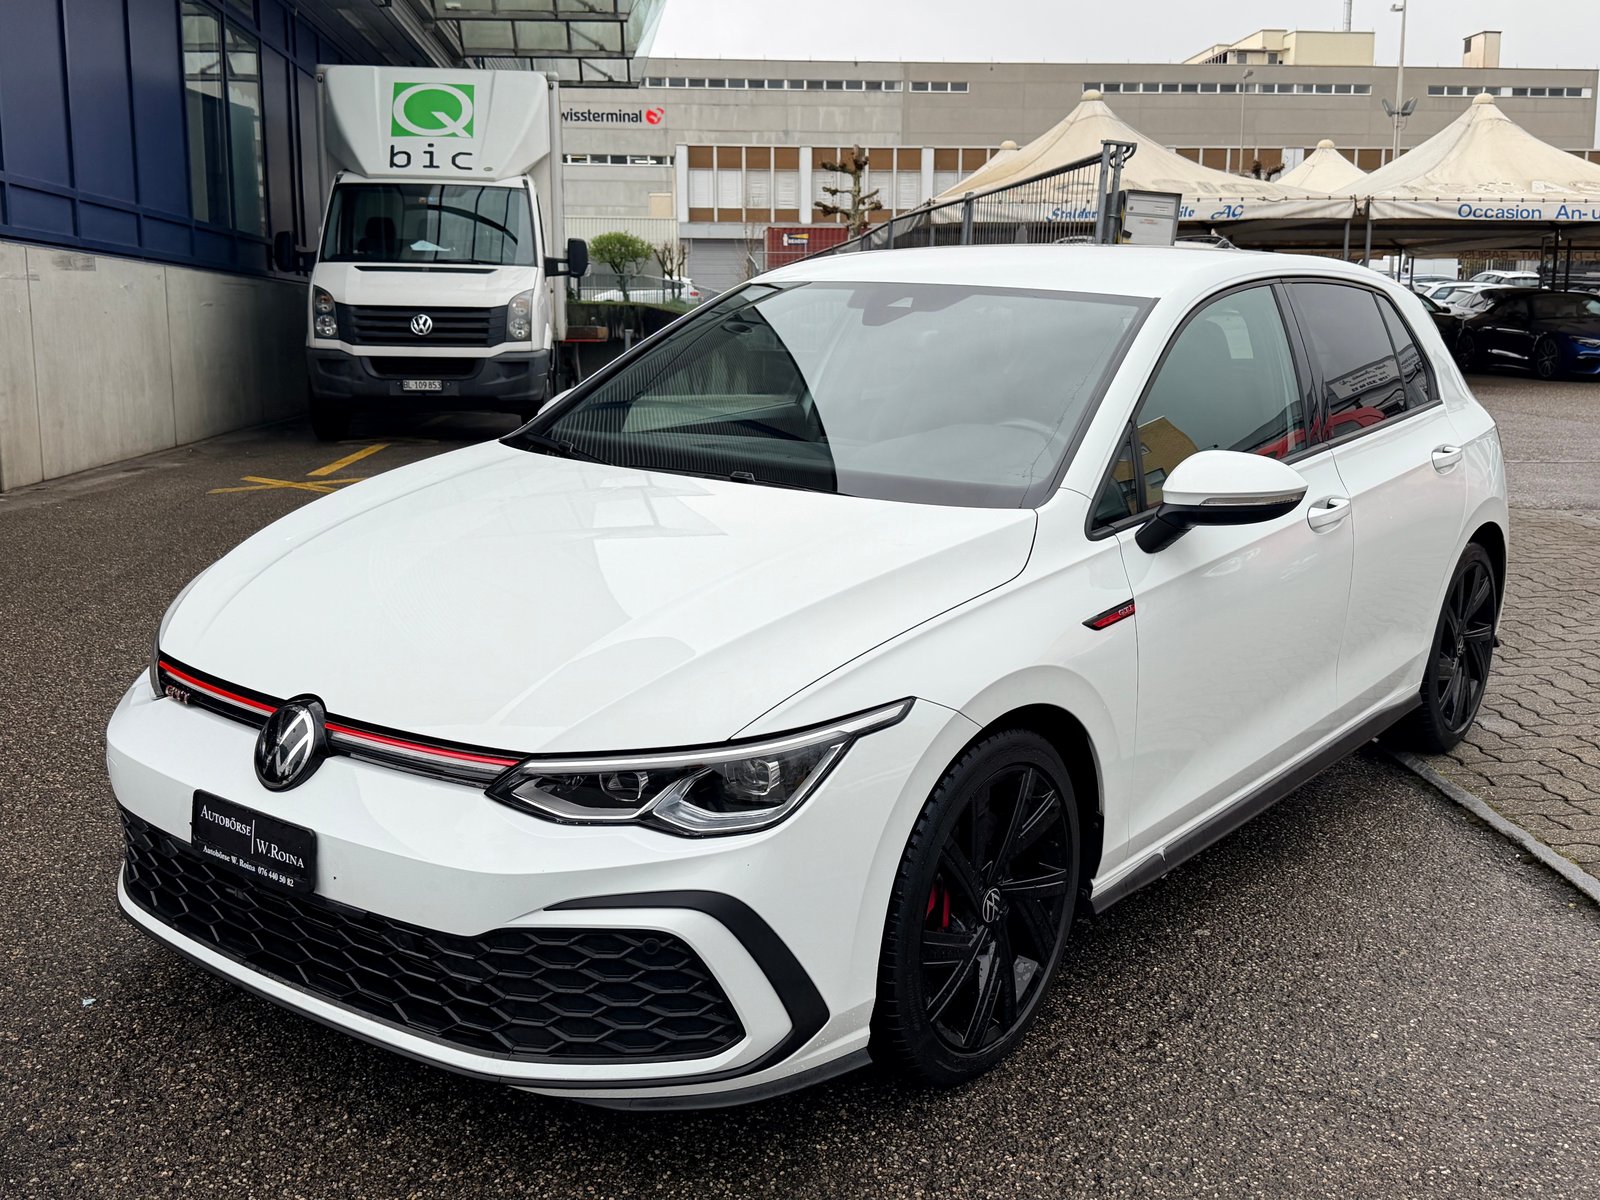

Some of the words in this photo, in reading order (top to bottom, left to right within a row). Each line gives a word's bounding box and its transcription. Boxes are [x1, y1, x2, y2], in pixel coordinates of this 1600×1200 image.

[392, 82, 475, 138] Q
[1210, 204, 1245, 220] AG
[1457, 203, 1542, 220] Occasion
[239, 858, 256, 873] Roina
[258, 866, 268, 877] 076
[268, 870, 279, 882] 440
[279, 874, 287, 885] 50
[287, 879, 295, 888] 82
